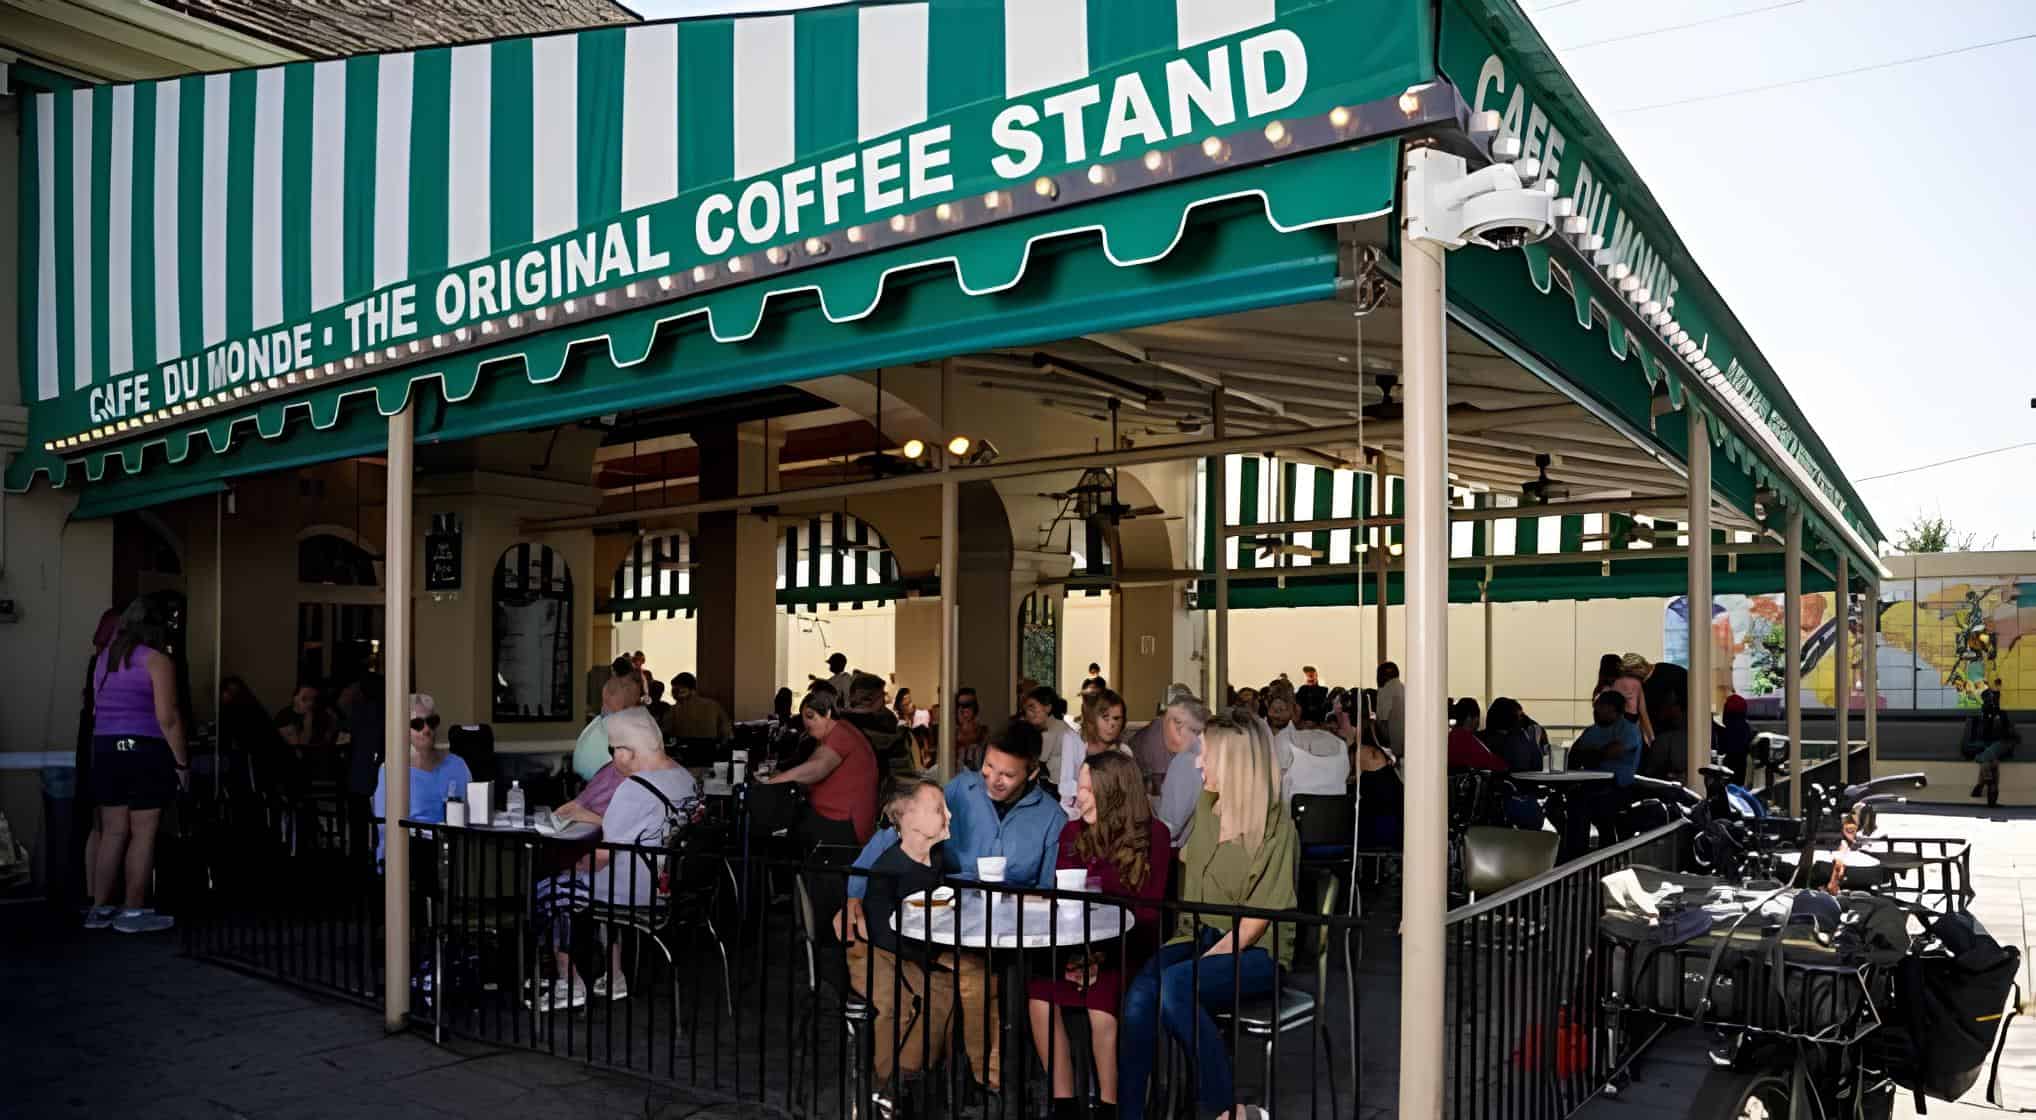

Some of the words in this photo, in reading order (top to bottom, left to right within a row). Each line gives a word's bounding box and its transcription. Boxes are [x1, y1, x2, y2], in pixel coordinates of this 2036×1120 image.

[90, 373, 150, 423] CAFE
[163, 356, 199, 405] DU
[208, 327, 313, 392] MONDE
[345, 285, 417, 352] THE
[436, 214, 670, 325] ORIGINAL
[696, 124, 954, 256] COFFEE
[991, 28, 1308, 179] STAND
